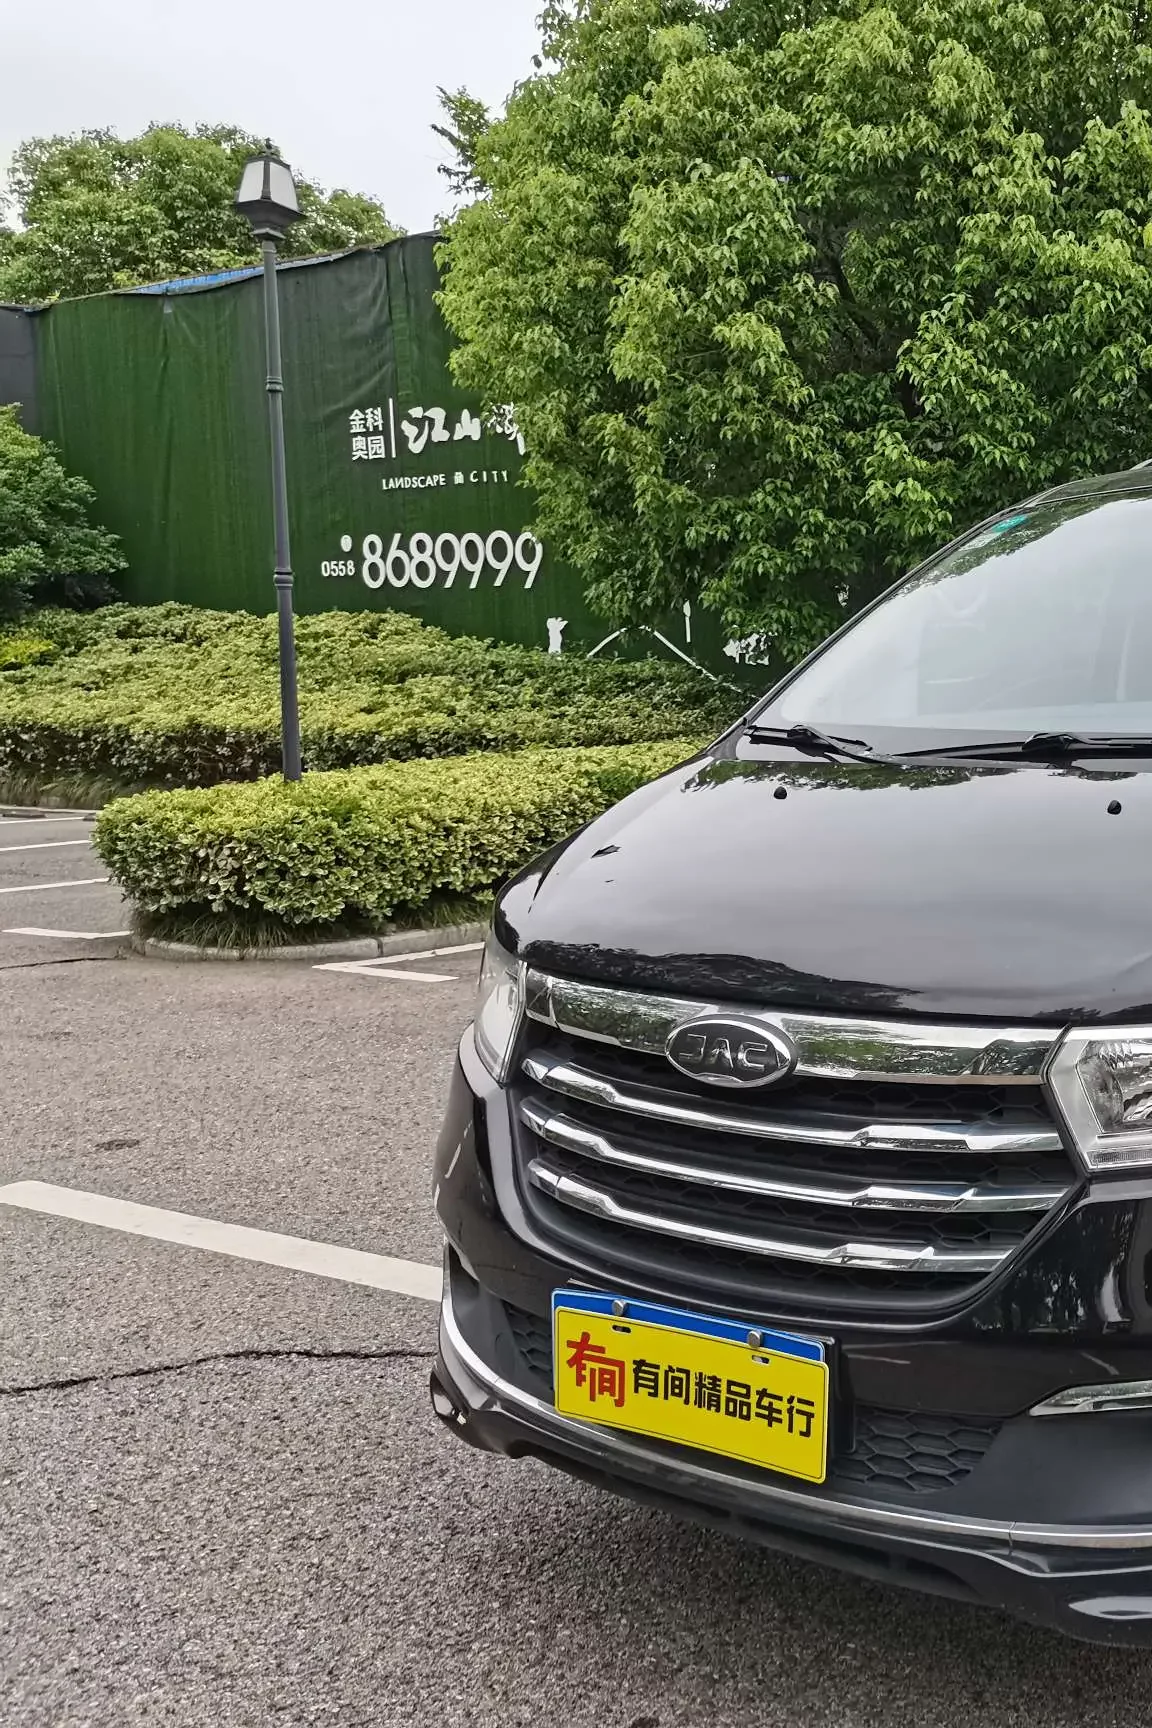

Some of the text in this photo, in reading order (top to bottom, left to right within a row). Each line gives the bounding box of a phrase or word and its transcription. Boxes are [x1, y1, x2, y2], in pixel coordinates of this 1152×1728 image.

[349, 407, 383, 433] 金科
[352, 435, 386, 461] 奥园
[382, 470, 508, 490] LANDSCAPE CITY
[321, 530, 543, 589] 0558 8689999
[679, 1034, 768, 1070] JAC
[633, 1359, 815, 1438] 有间精品车行
